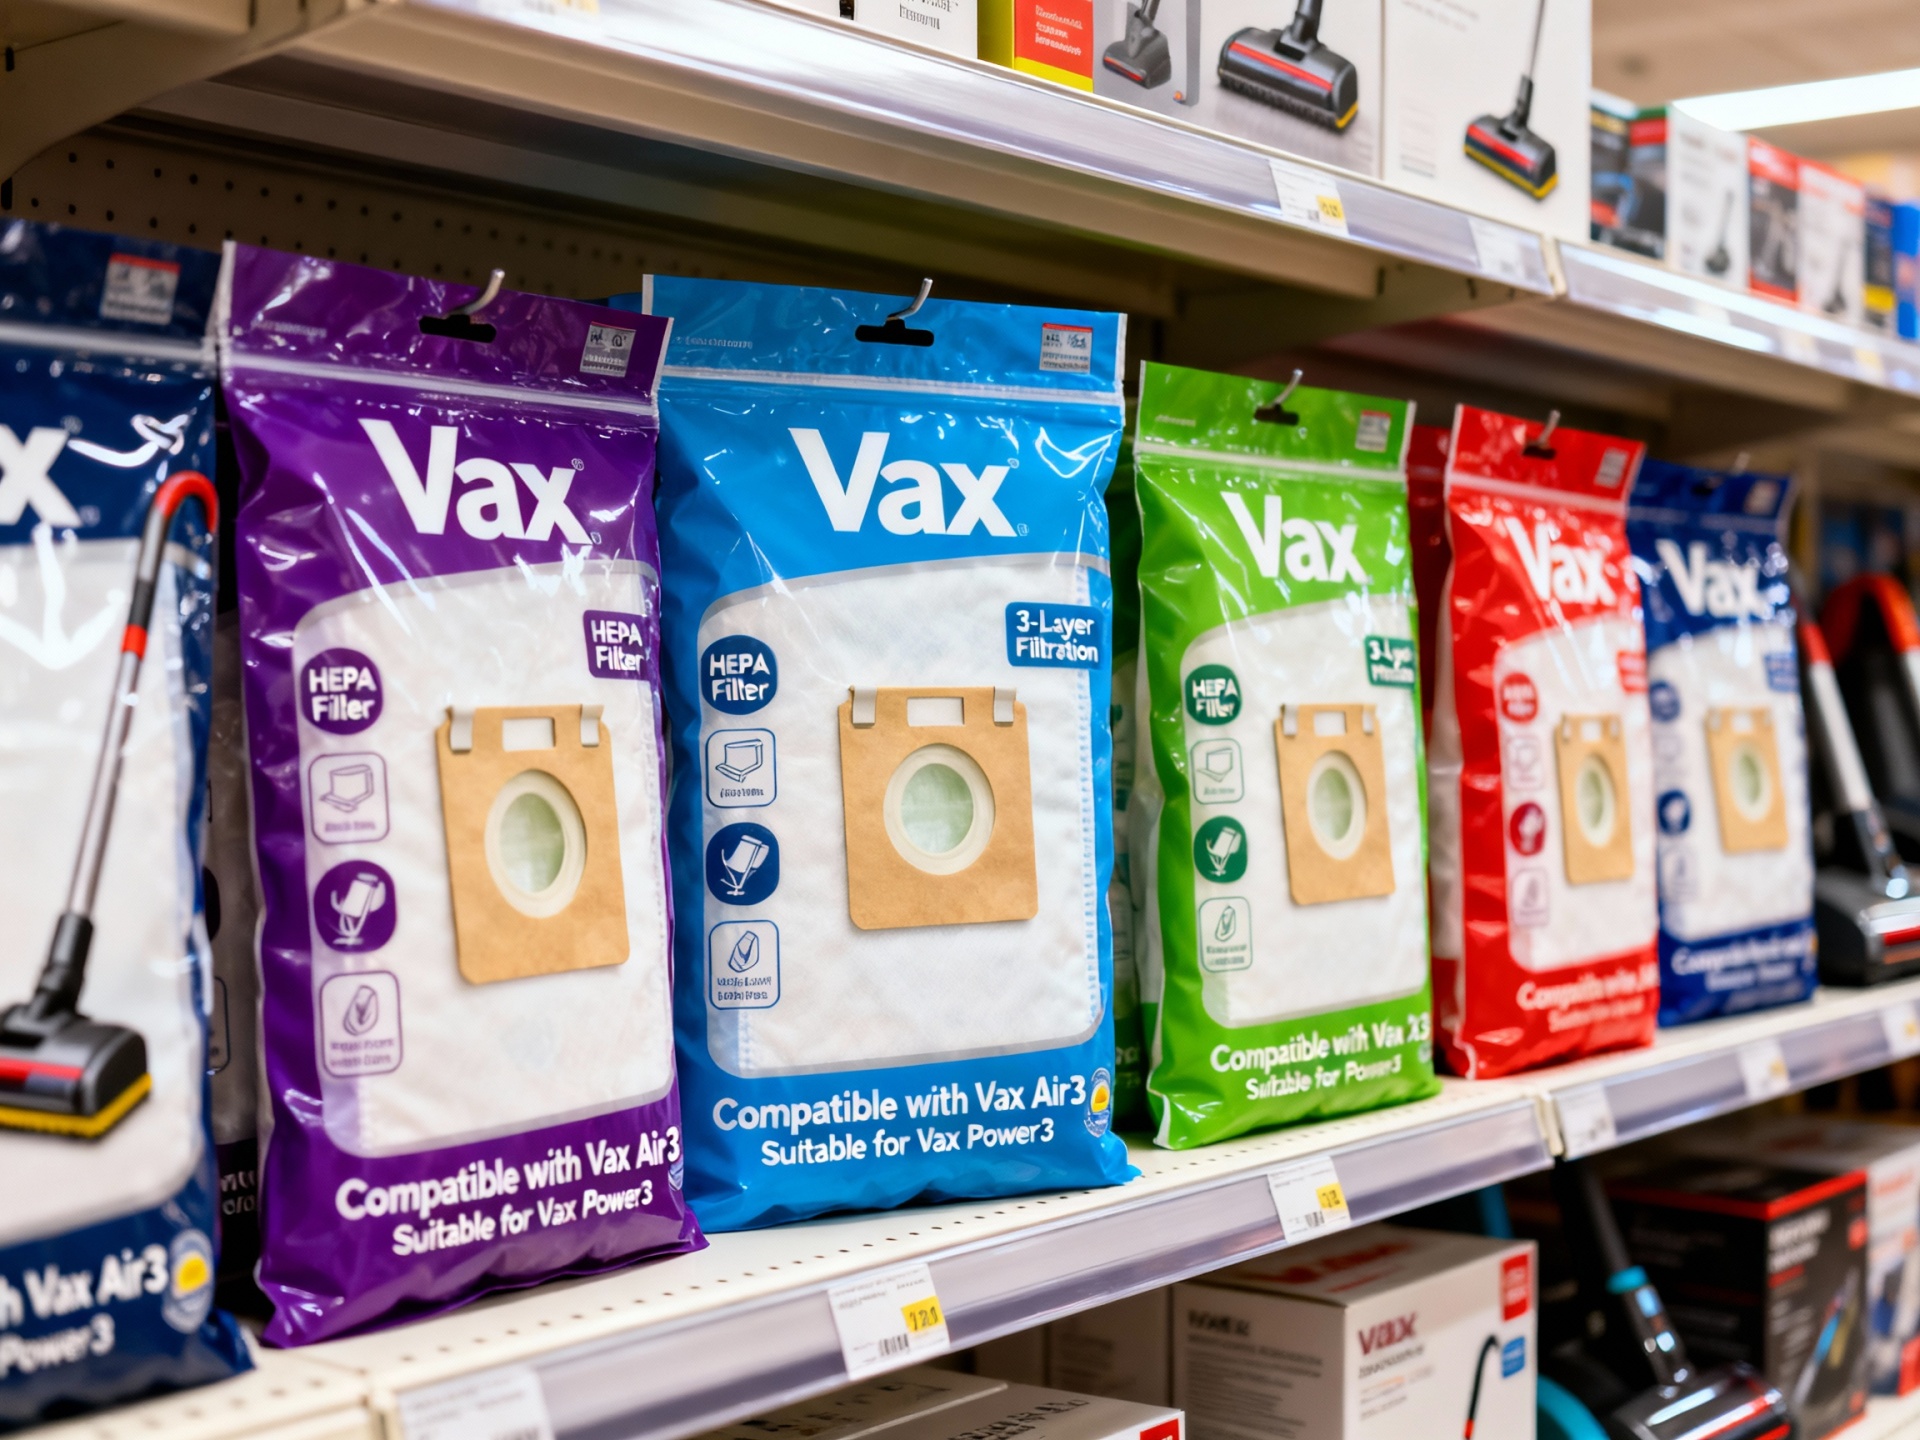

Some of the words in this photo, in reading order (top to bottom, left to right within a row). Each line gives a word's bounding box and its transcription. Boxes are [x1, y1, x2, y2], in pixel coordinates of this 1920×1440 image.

[358, 418, 593, 545] Vax
[788, 428, 1018, 537] Vax
[1220, 491, 1369, 584] Vax
[1504, 516, 1616, 606] Vax
[1655, 538, 1771, 620] Vax
[591, 619, 643, 647] HEPA
[1016, 609, 1095, 641] 3-Layer
[309, 666, 377, 693] HEPA
[710, 652, 771, 677] HEPA
[1210, 1030, 1330, 1074] Compatible
[712, 1088, 898, 1136] Compatible
[905, 1082, 969, 1119] with
[975, 1080, 1025, 1113] Vax
[1031, 1074, 1086, 1109] Air3
[872, 1128, 911, 1158] for
[916, 1127, 961, 1153] Vax
[967, 1117, 1054, 1150] Power3
[335, 1157, 520, 1221] Compatible
[523, 1145, 582, 1190] with
[585, 1139, 631, 1176] Vax
[636, 1126, 680, 1169] Air3
[392, 1210, 496, 1256] Suitable
[500, 1203, 534, 1236] for
[537, 1197, 577, 1227] Vax
[582, 1180, 653, 1219] Power3
